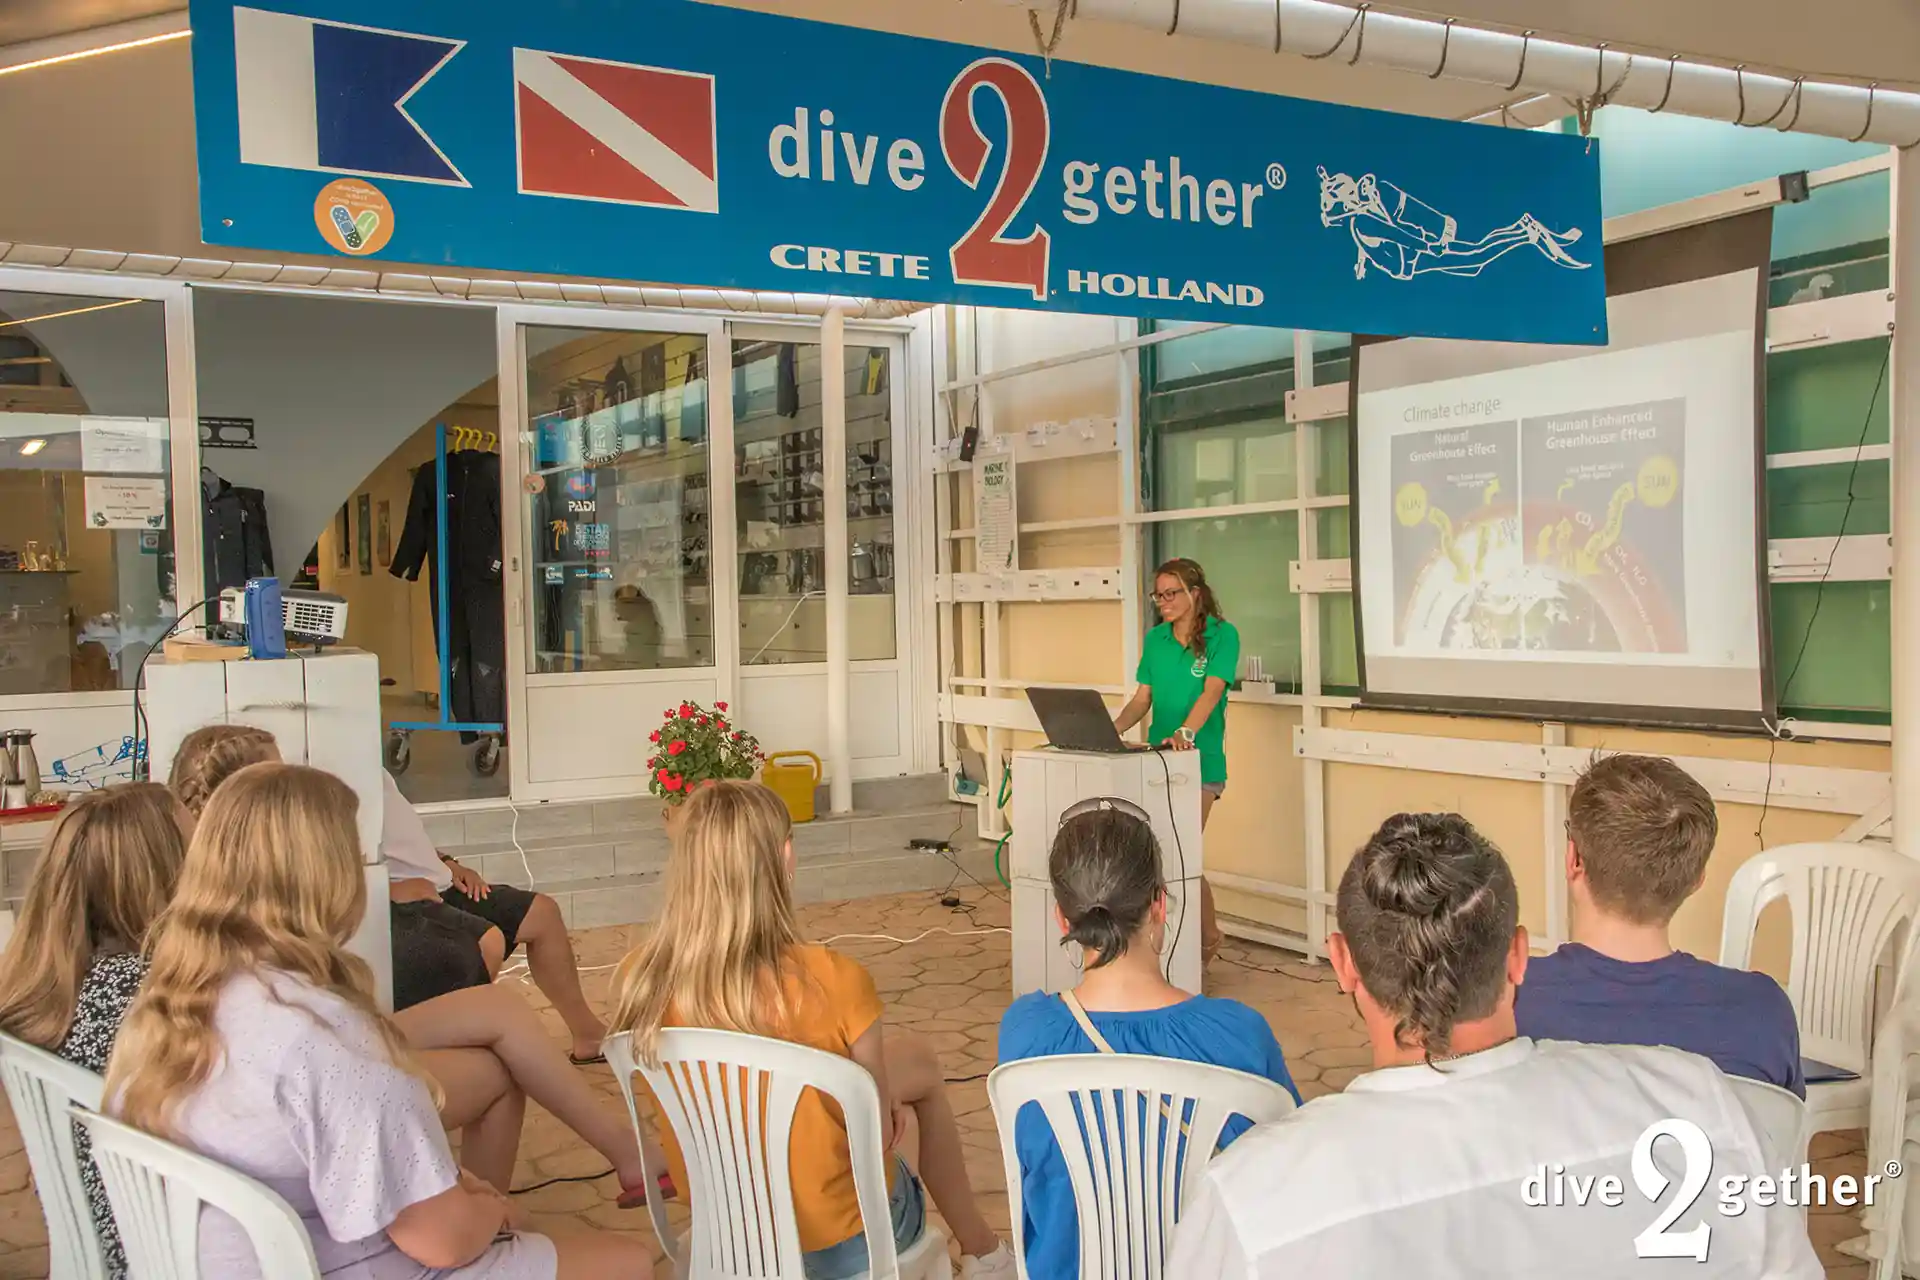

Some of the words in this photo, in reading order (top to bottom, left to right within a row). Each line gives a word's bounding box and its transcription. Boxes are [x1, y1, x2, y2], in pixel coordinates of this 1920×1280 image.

[768, 106, 925, 191] dive
[938, 56, 1051, 301] 2
[769, 244, 929, 280] CRETE
[1067, 269, 1264, 307] HOLLAND
[1403, 404, 1450, 423] Climate
[1453, 398, 1501, 416] change
[1547, 419, 1588, 433] Human
[1592, 408, 1653, 429] Enhanced
[1434, 430, 1469, 445] Natural
[1546, 432, 1618, 449] Greenhouse
[1620, 426, 1656, 442] Effect
[1409, 448, 1466, 463] Greenhouse
[1467, 443, 1497, 457] Effect
[568, 500, 596, 512] PADI
